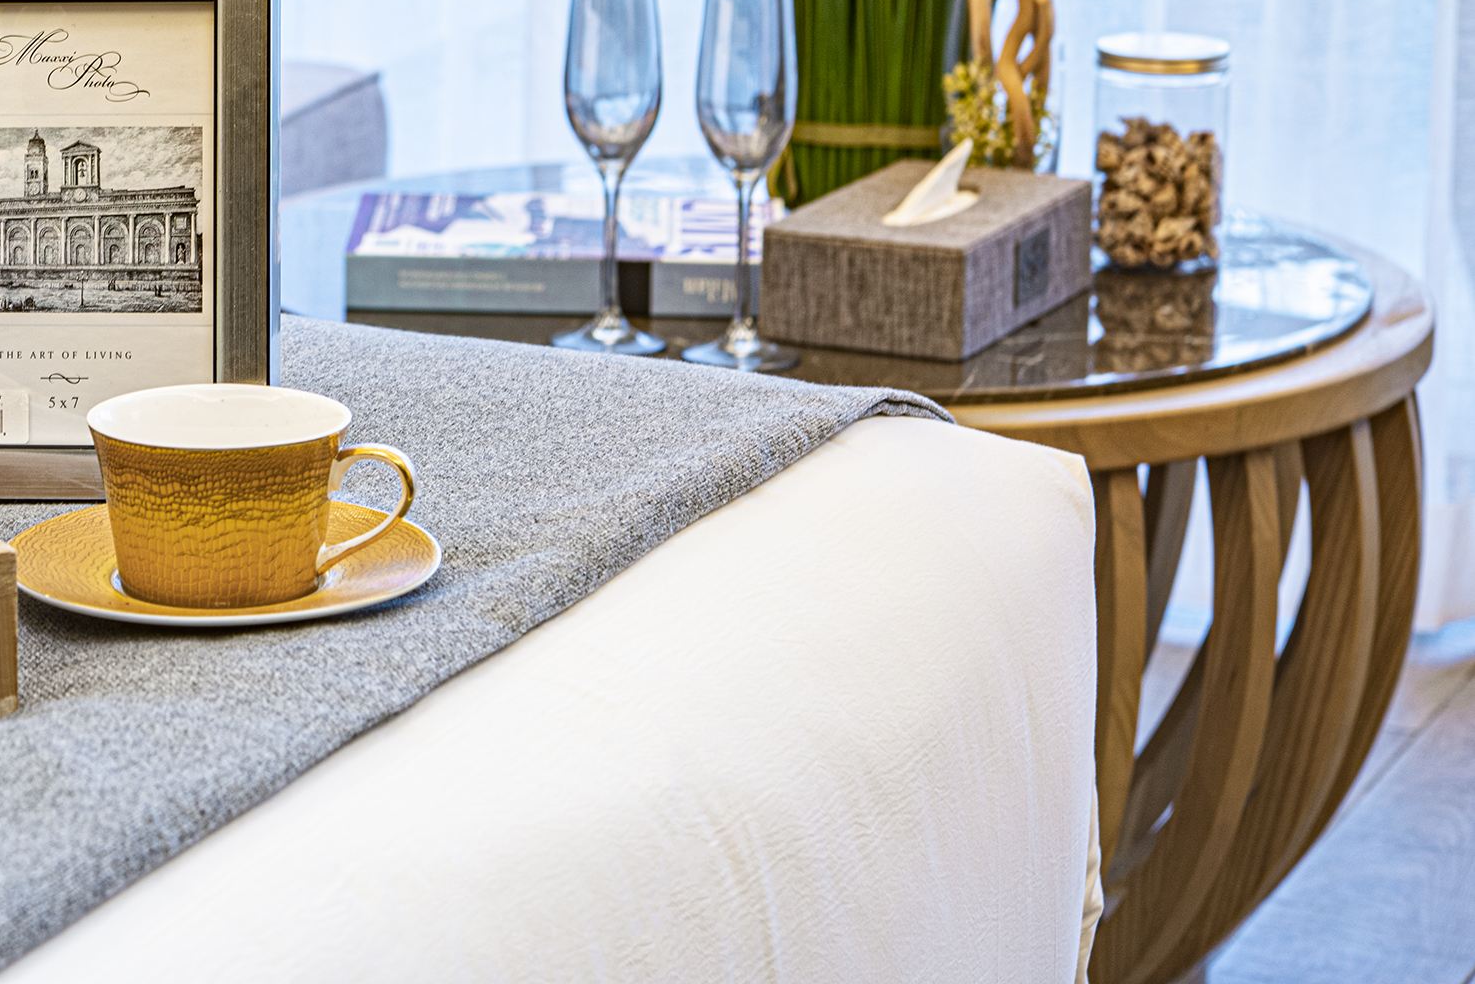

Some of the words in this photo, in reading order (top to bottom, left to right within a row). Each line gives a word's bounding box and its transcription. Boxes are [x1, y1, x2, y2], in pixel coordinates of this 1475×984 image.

[47, 51, 151, 102] Photo
[30, 351, 55, 360] ART
[61, 351, 78, 360] OF
[85, 350, 133, 360] LIVING
[48, 397, 56, 409] 5
[71, 397, 79, 409] 7
